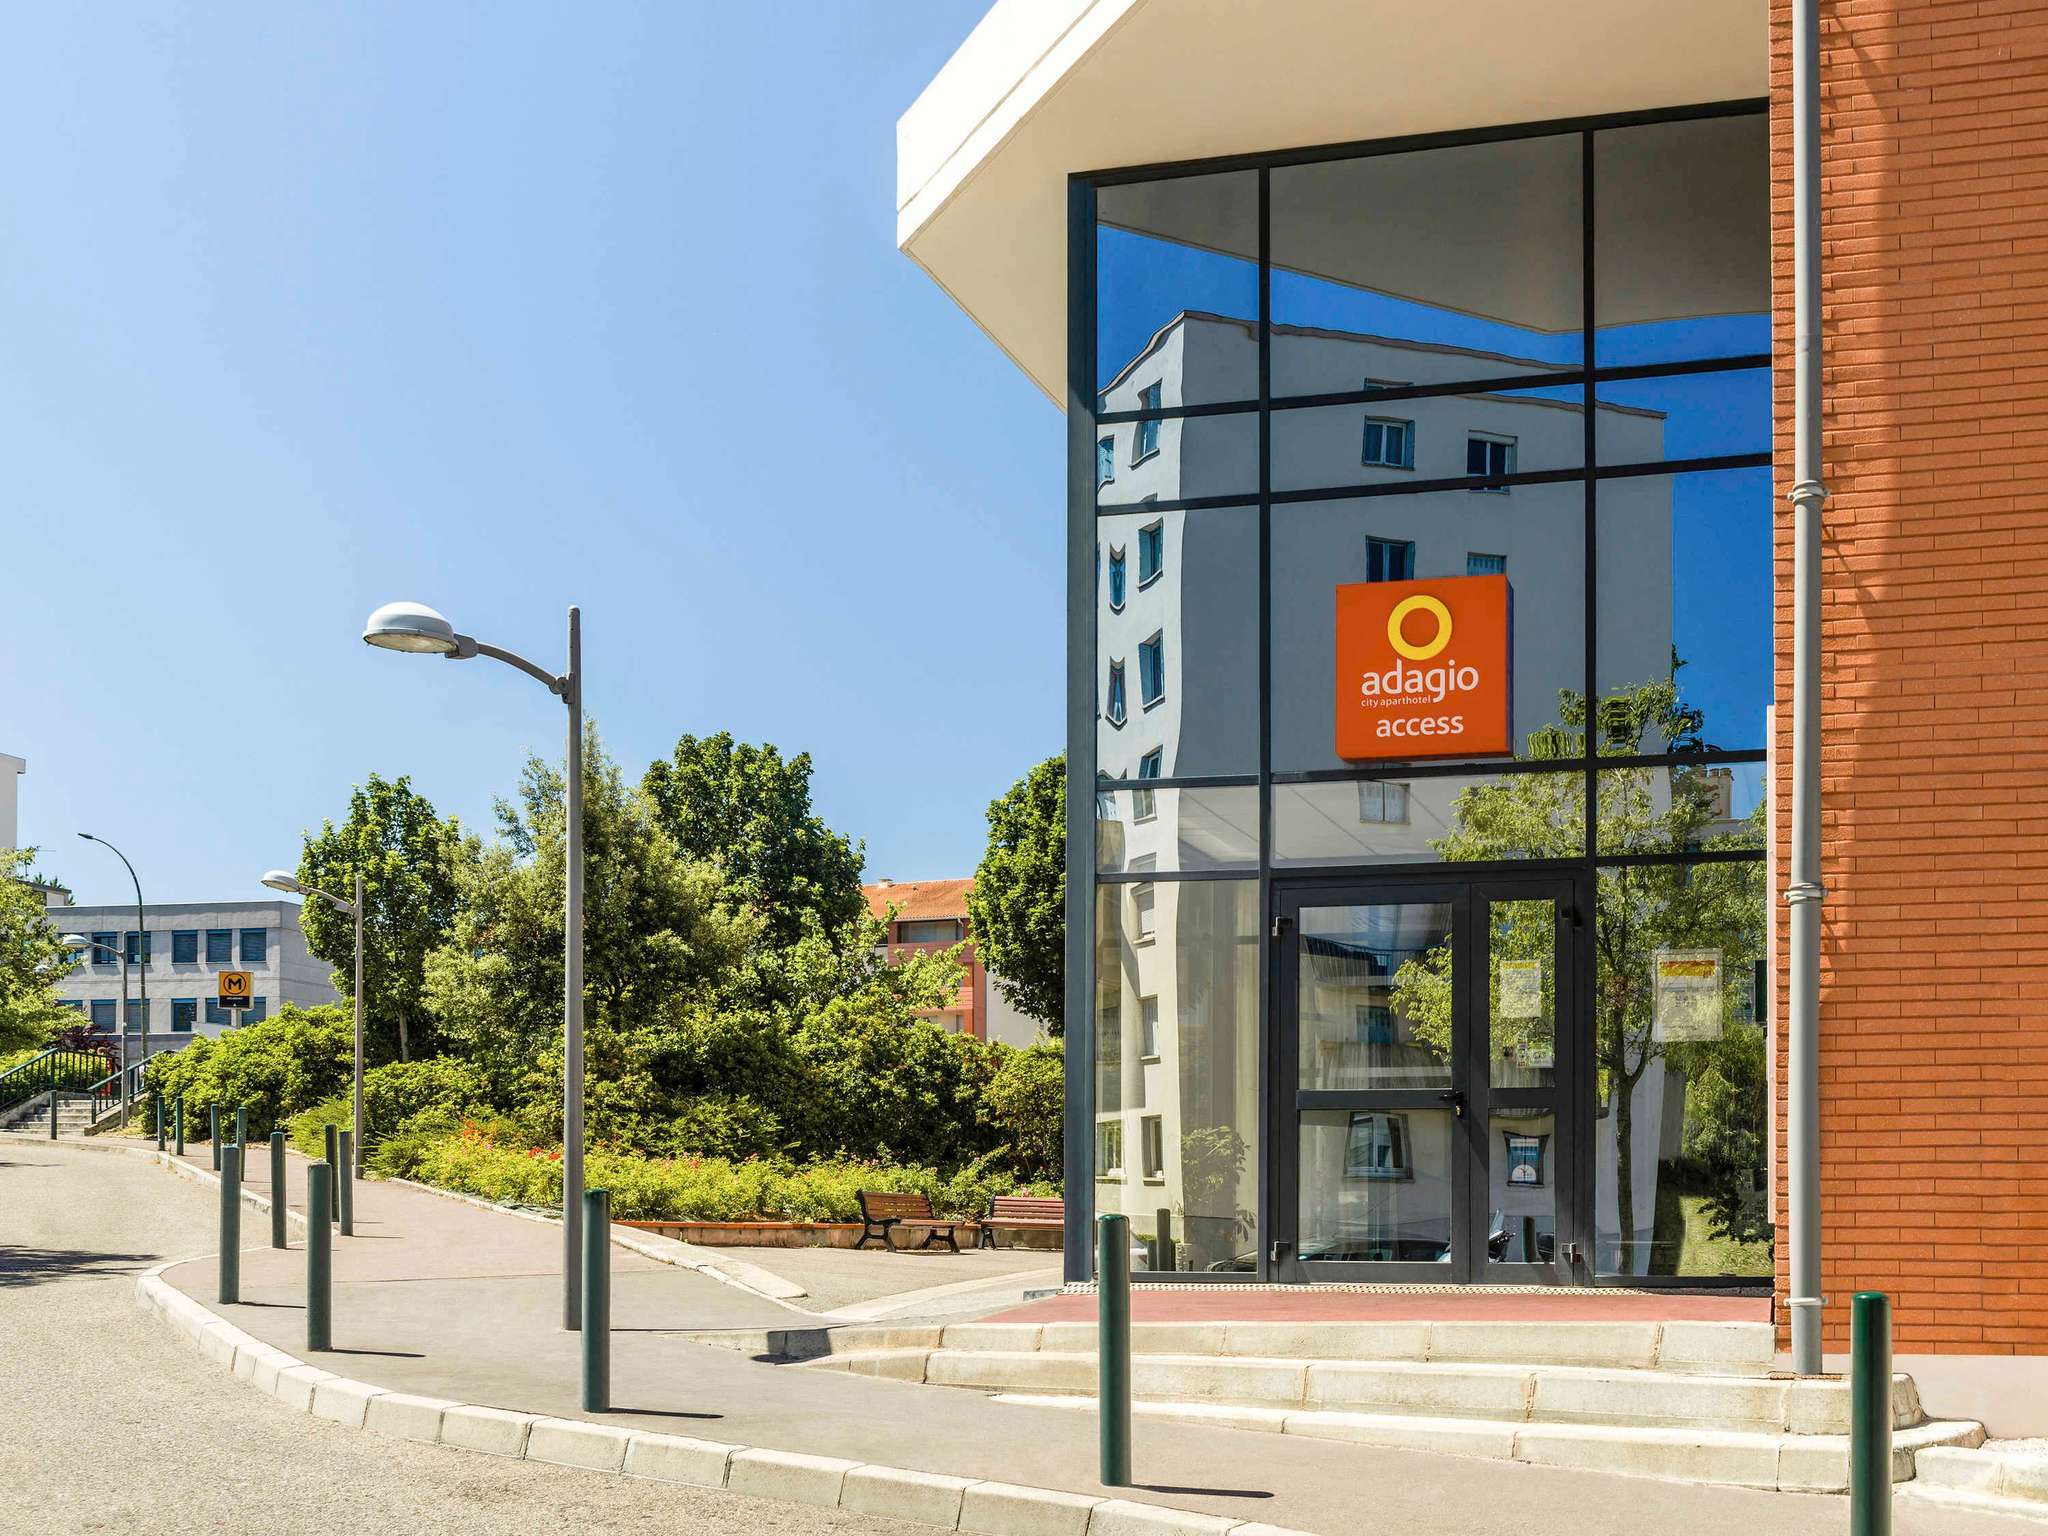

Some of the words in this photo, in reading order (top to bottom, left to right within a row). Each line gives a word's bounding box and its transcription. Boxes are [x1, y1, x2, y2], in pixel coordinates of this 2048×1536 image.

[1361, 658, 1479, 703] adagio
[1361, 698, 1379, 709] city
[1380, 695, 1431, 707] aparthotel
[1376, 715, 1464, 737] access
[228, 978, 242, 990] M
